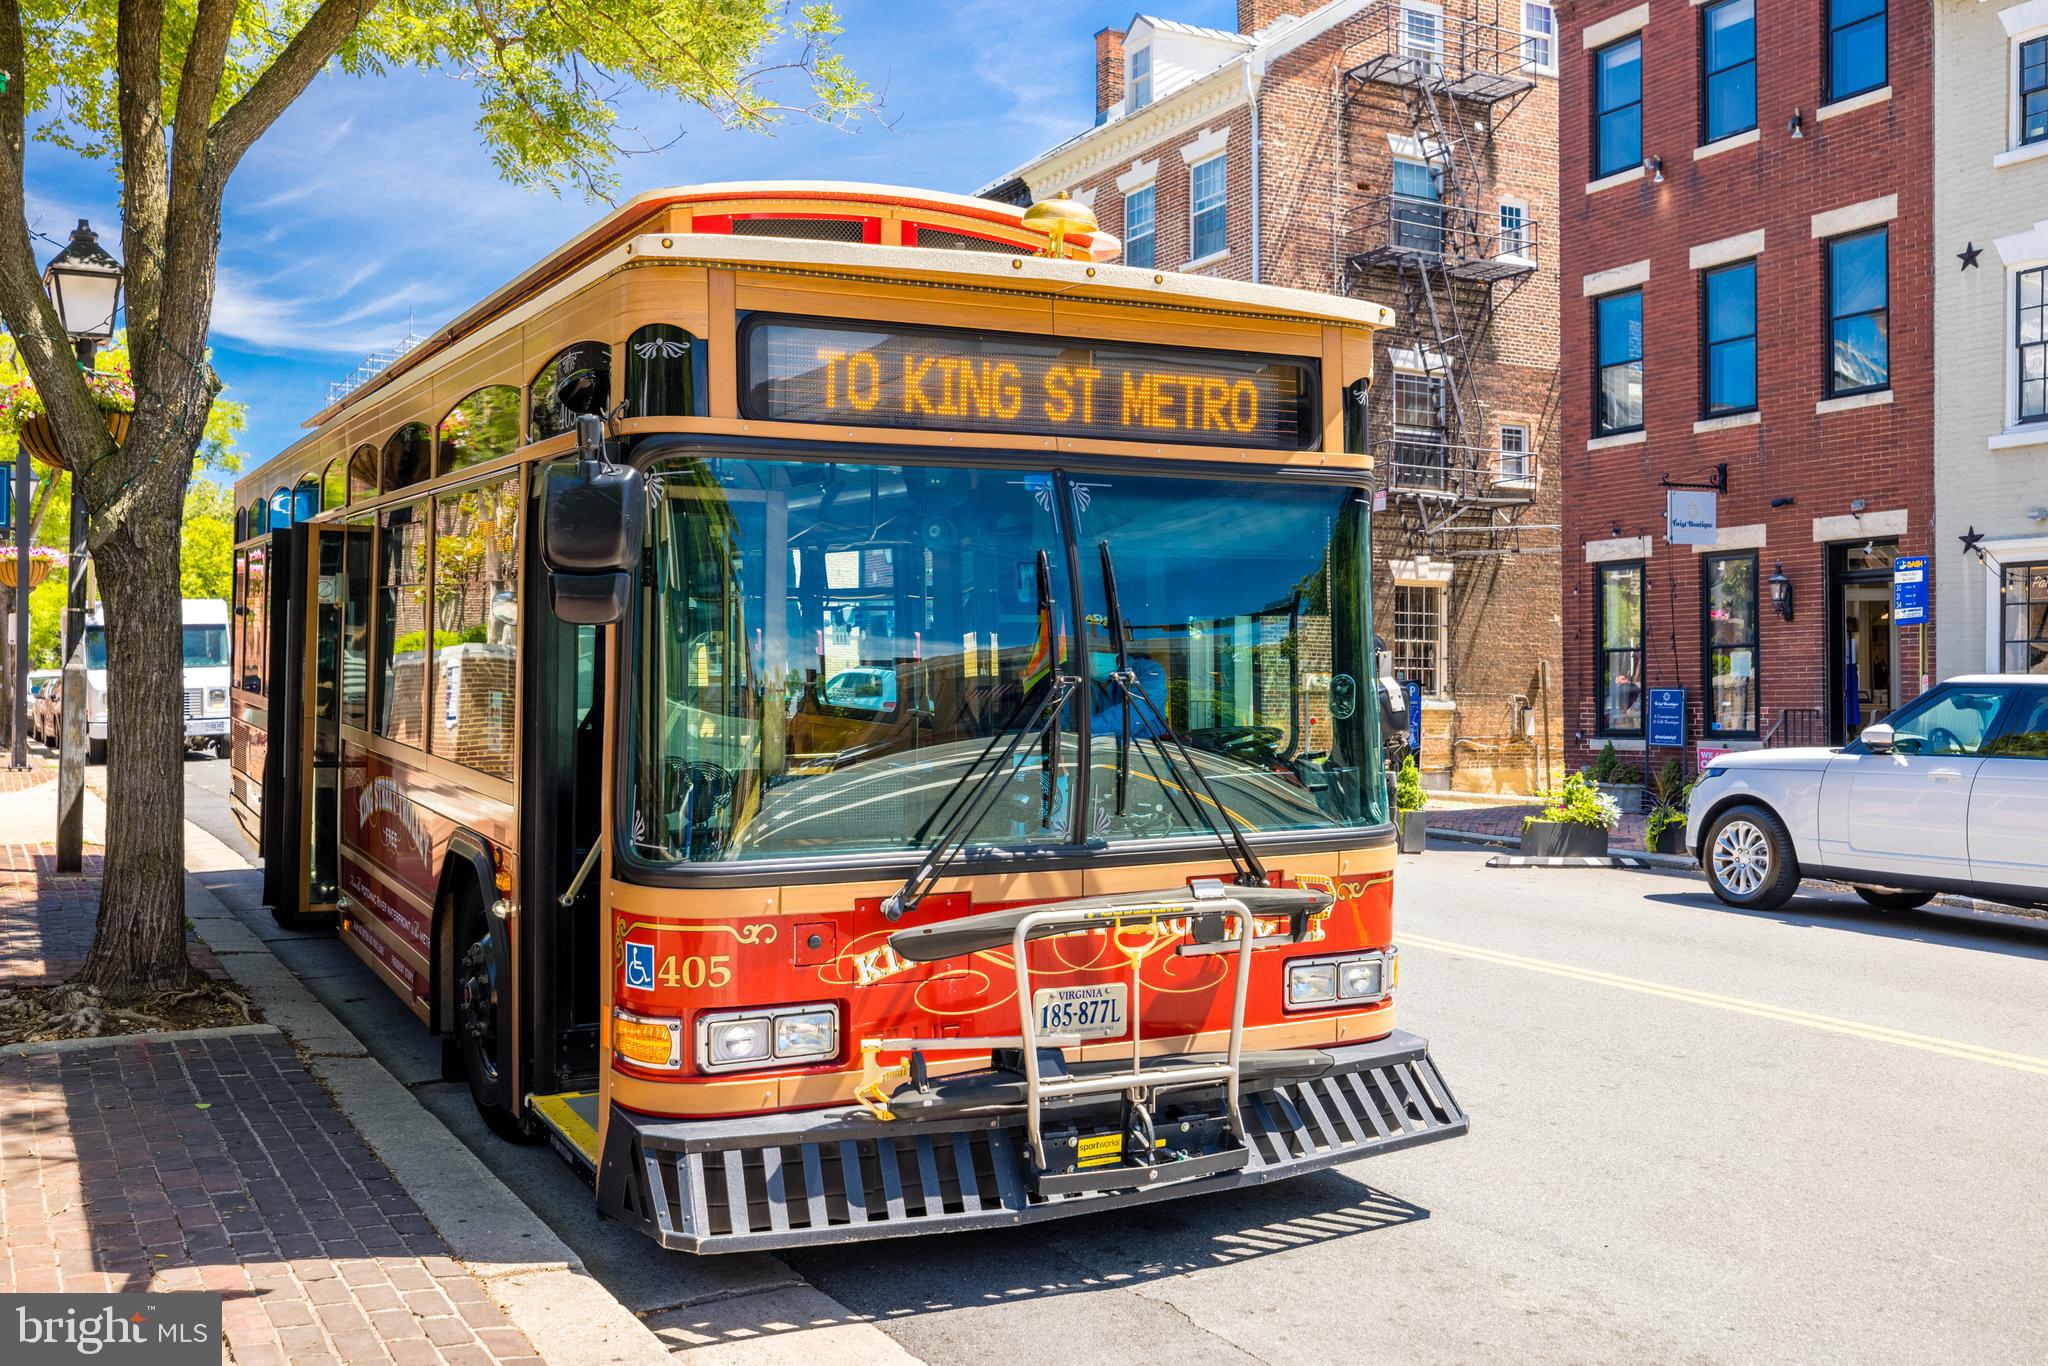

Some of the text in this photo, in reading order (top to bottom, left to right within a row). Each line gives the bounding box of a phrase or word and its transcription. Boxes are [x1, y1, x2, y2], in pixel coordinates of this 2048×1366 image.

[817, 349, 1258, 432] TO KING ST METRO
[1672, 518, 1713, 530] Twist Boutique
[1907, 560, 1923, 568] DASH
[1896, 584, 1902, 592] 30
[2032, 575, 2048, 589] Pa
[1896, 593, 1901, 601] 31
[1896, 601, 1902, 609] 34
[1409, 685, 1416, 697] P
[385, 827, 398, 849] FREE
[419, 930, 431, 949] METR
[657, 955, 732, 989] 405
[1059, 988, 1103, 1000] VIRGINIA
[1041, 999, 1121, 1029] 185-877L
[1079, 1139, 1120, 1152] sportworks
